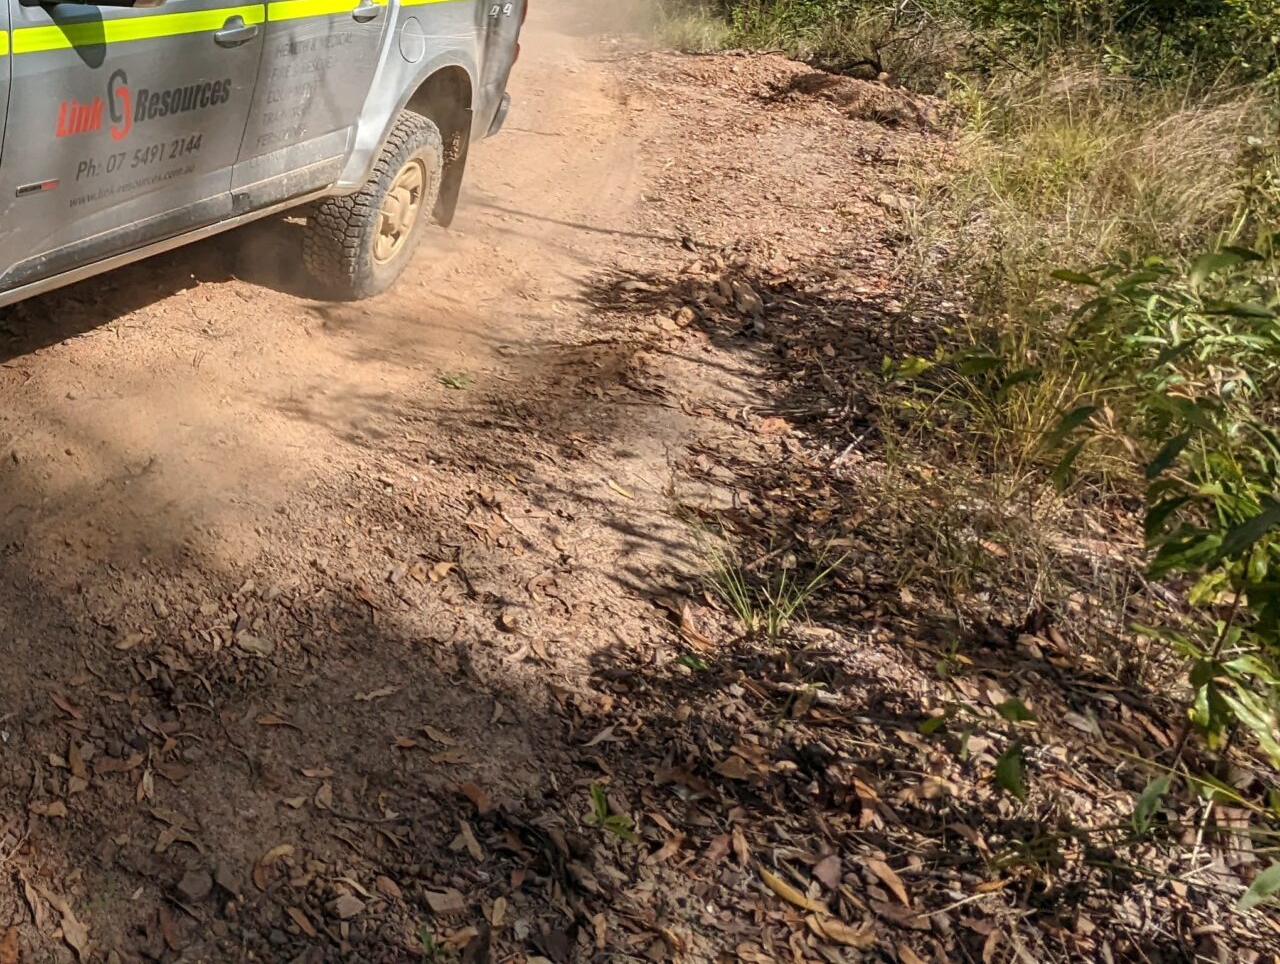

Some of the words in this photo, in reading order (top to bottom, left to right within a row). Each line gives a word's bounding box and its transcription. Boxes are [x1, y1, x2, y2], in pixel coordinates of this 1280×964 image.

[56, 96, 106, 140] Link
[133, 78, 232, 123] Resources
[76, 158, 100, 181] Ph:
[106, 152, 126, 174] 07
[131, 142, 164, 168] 5491
[169, 134, 203, 159] 2144
